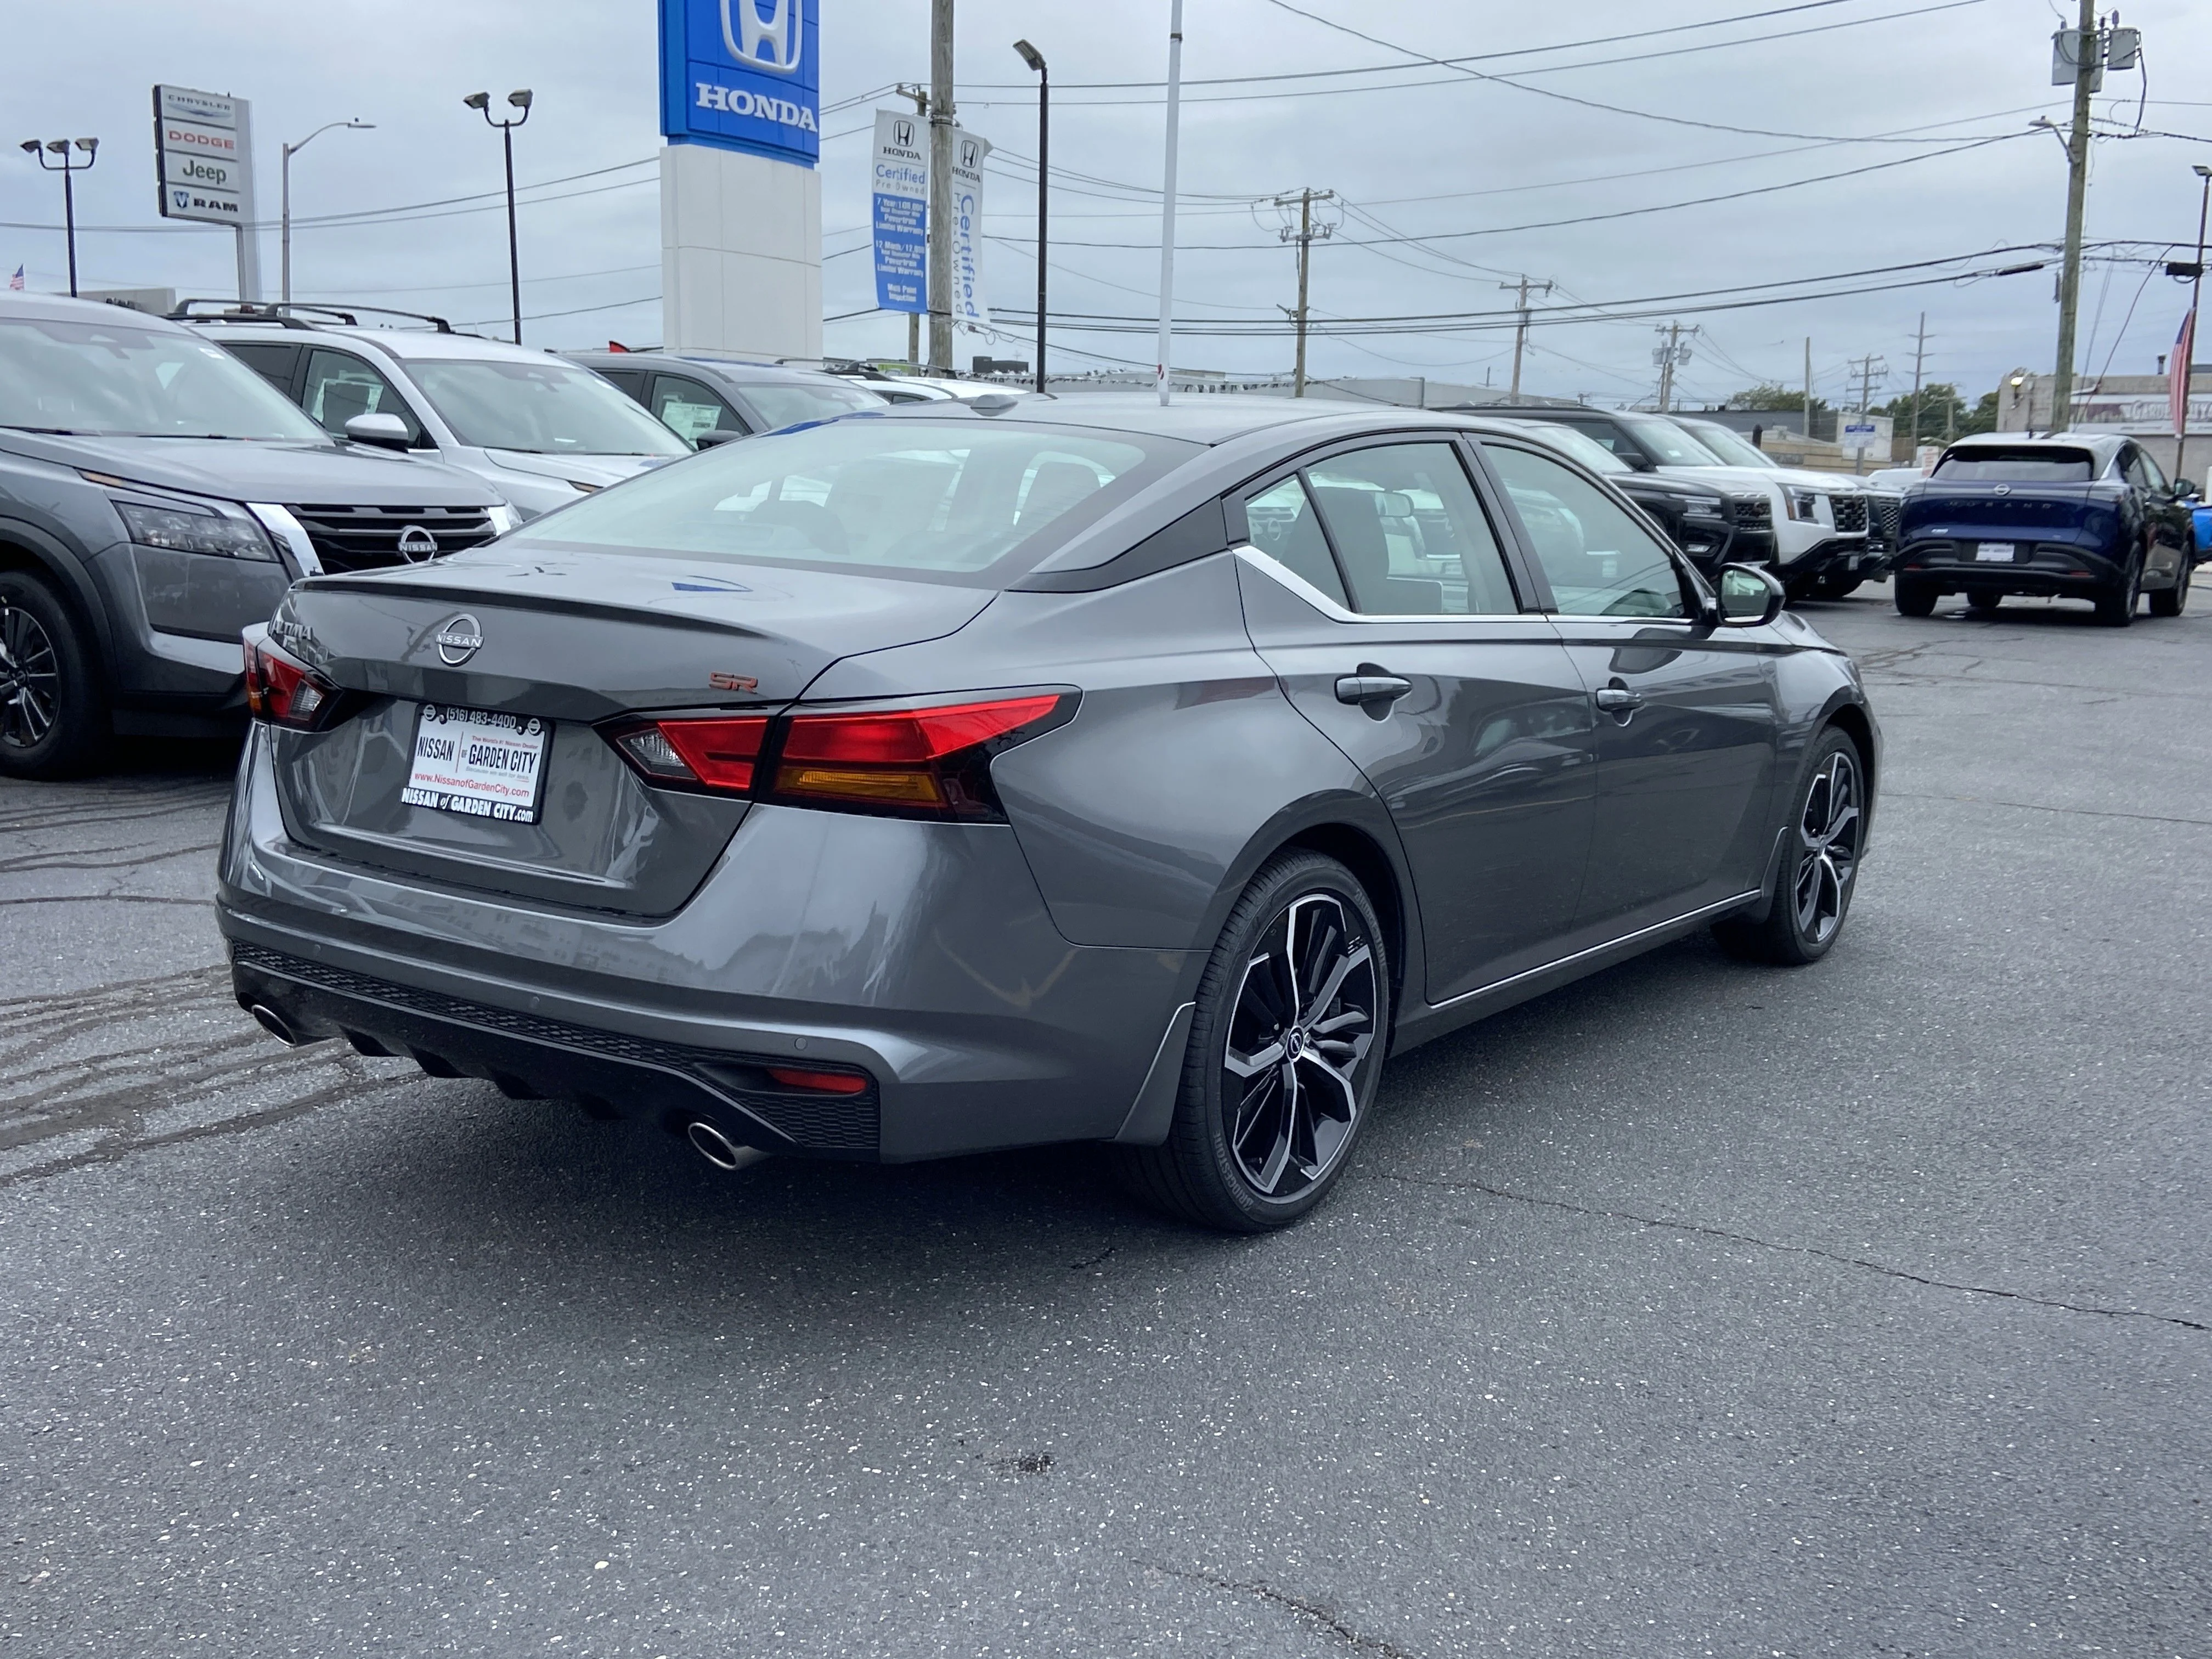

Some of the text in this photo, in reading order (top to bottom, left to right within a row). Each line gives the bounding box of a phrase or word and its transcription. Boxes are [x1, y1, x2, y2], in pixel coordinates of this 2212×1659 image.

[168, 94, 231, 111] CHRYSLER
[696, 82, 818, 133] HONDA
[168, 131, 235, 149] DODGE
[883, 146, 921, 160] HONDA
[183, 160, 227, 184] Jeep
[876, 164, 926, 184] Certified
[952, 166, 981, 183] HONDA
[194, 198, 238, 212] RAM
[952, 193, 964, 314] Pre-Owned
[960, 194, 979, 318] Certified
[437, 634, 482, 647] NISSAN
[709, 672, 758, 694] SR
[446, 707, 469, 722] (516)
[470, 712, 517, 729] 483-4400
[417, 736, 455, 761] NISSAN
[469, 744, 537, 774] GARDEN CITY
[414, 771, 530, 798] www.NissanofGardenCity.com
[401, 787, 534, 823] NISSAN of GARDEN CITY.com
